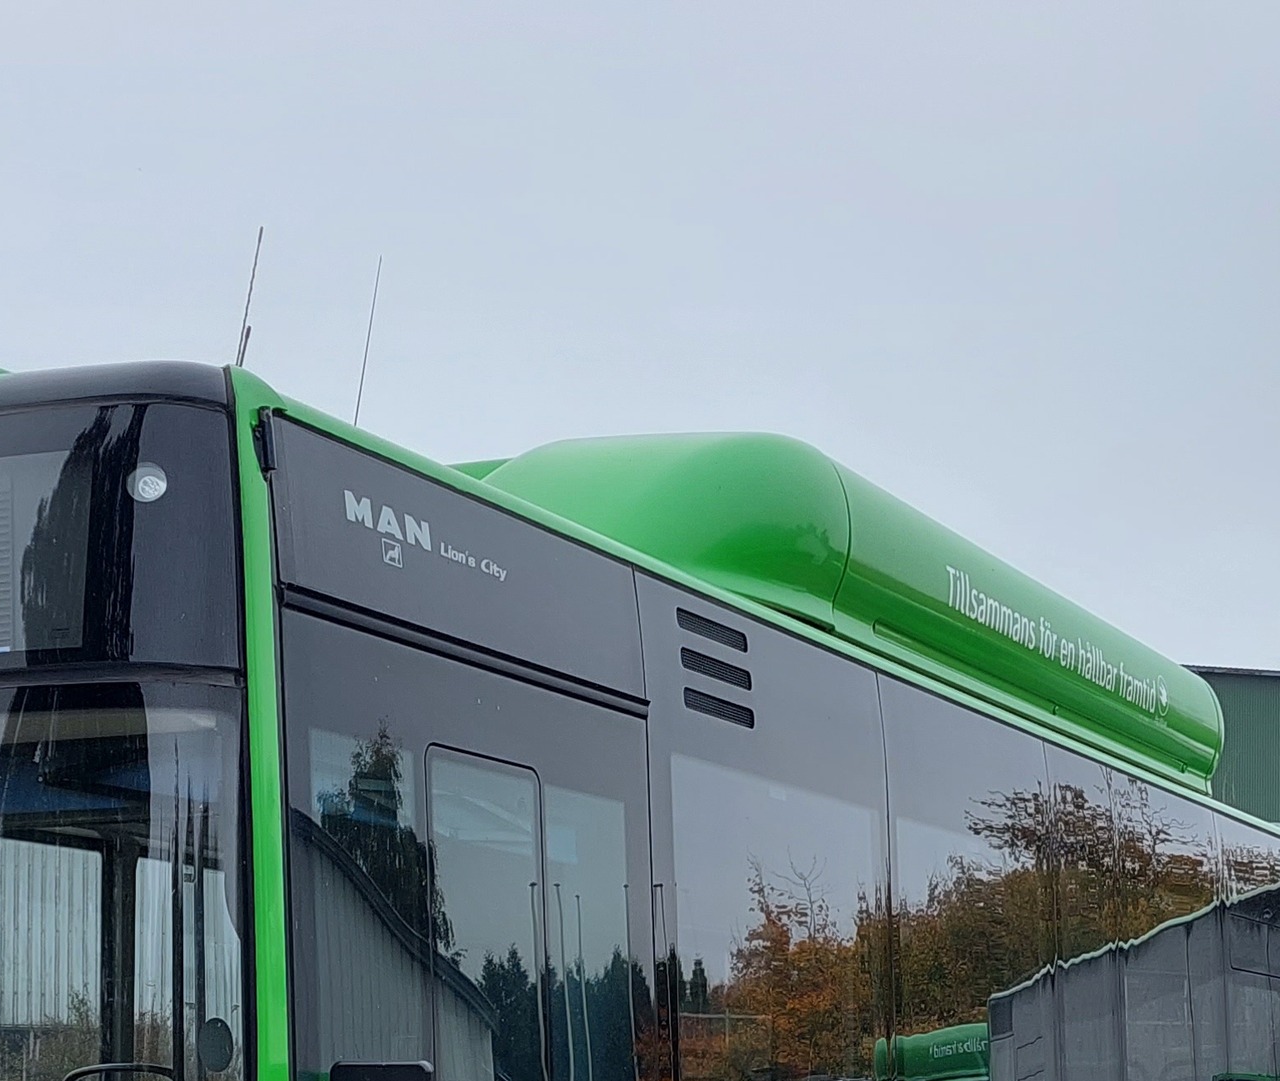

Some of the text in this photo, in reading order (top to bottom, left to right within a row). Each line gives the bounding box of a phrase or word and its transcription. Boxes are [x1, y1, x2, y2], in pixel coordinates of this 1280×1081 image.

[344, 489, 431, 551] MAN
[440, 542, 508, 582] Lion's City
[946, 565, 1157, 713] Tillsammans för en hållbar framtid
